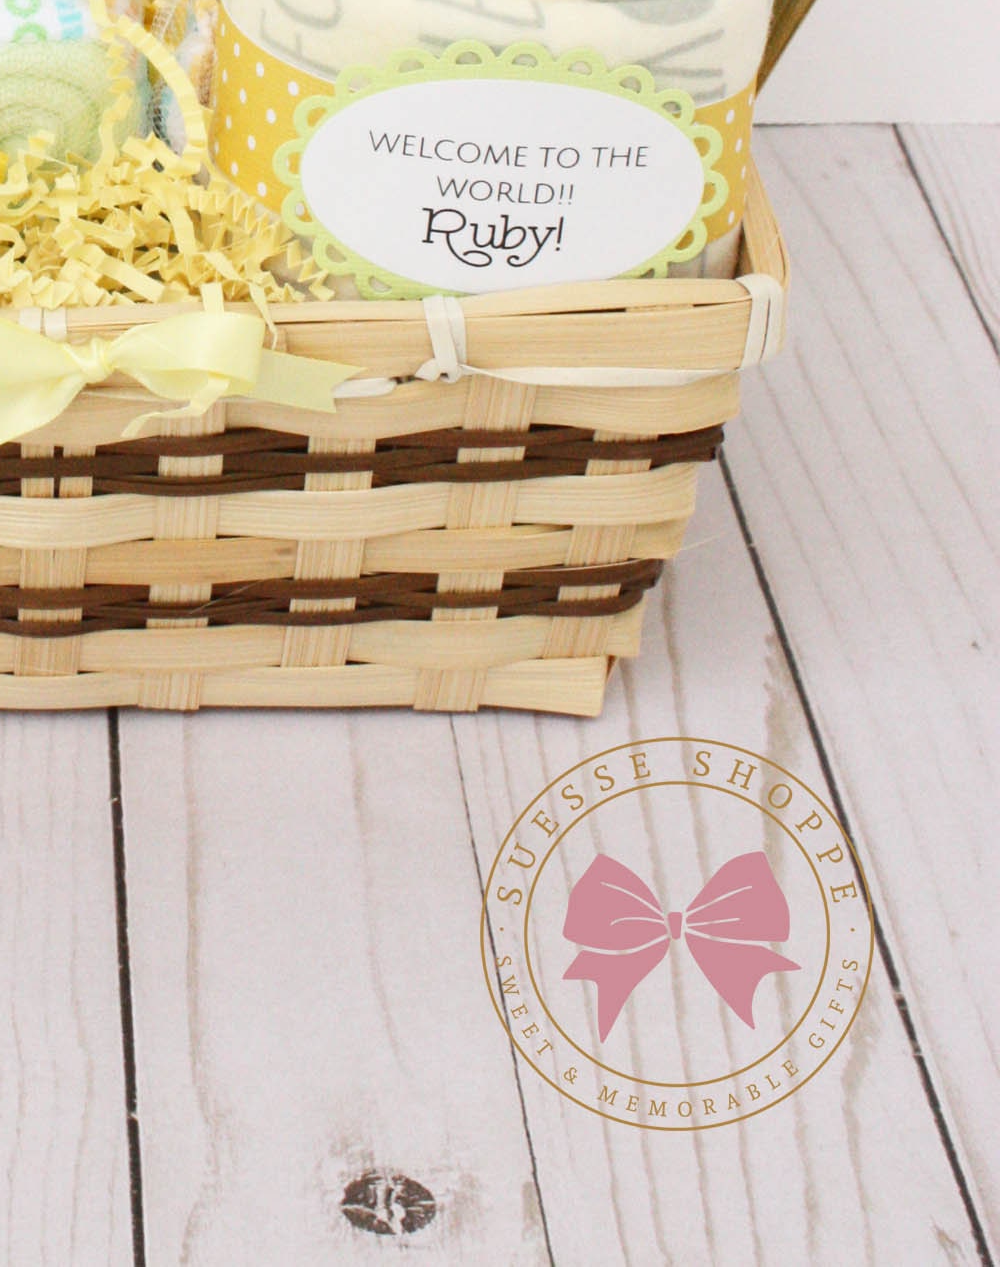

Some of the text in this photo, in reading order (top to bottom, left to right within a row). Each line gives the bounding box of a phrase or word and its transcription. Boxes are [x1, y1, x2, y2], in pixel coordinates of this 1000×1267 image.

[368, 129, 650, 169] WELCOME TO THE
[436, 175, 576, 206] WORLD!!
[421, 207, 566, 268] Ruby!
